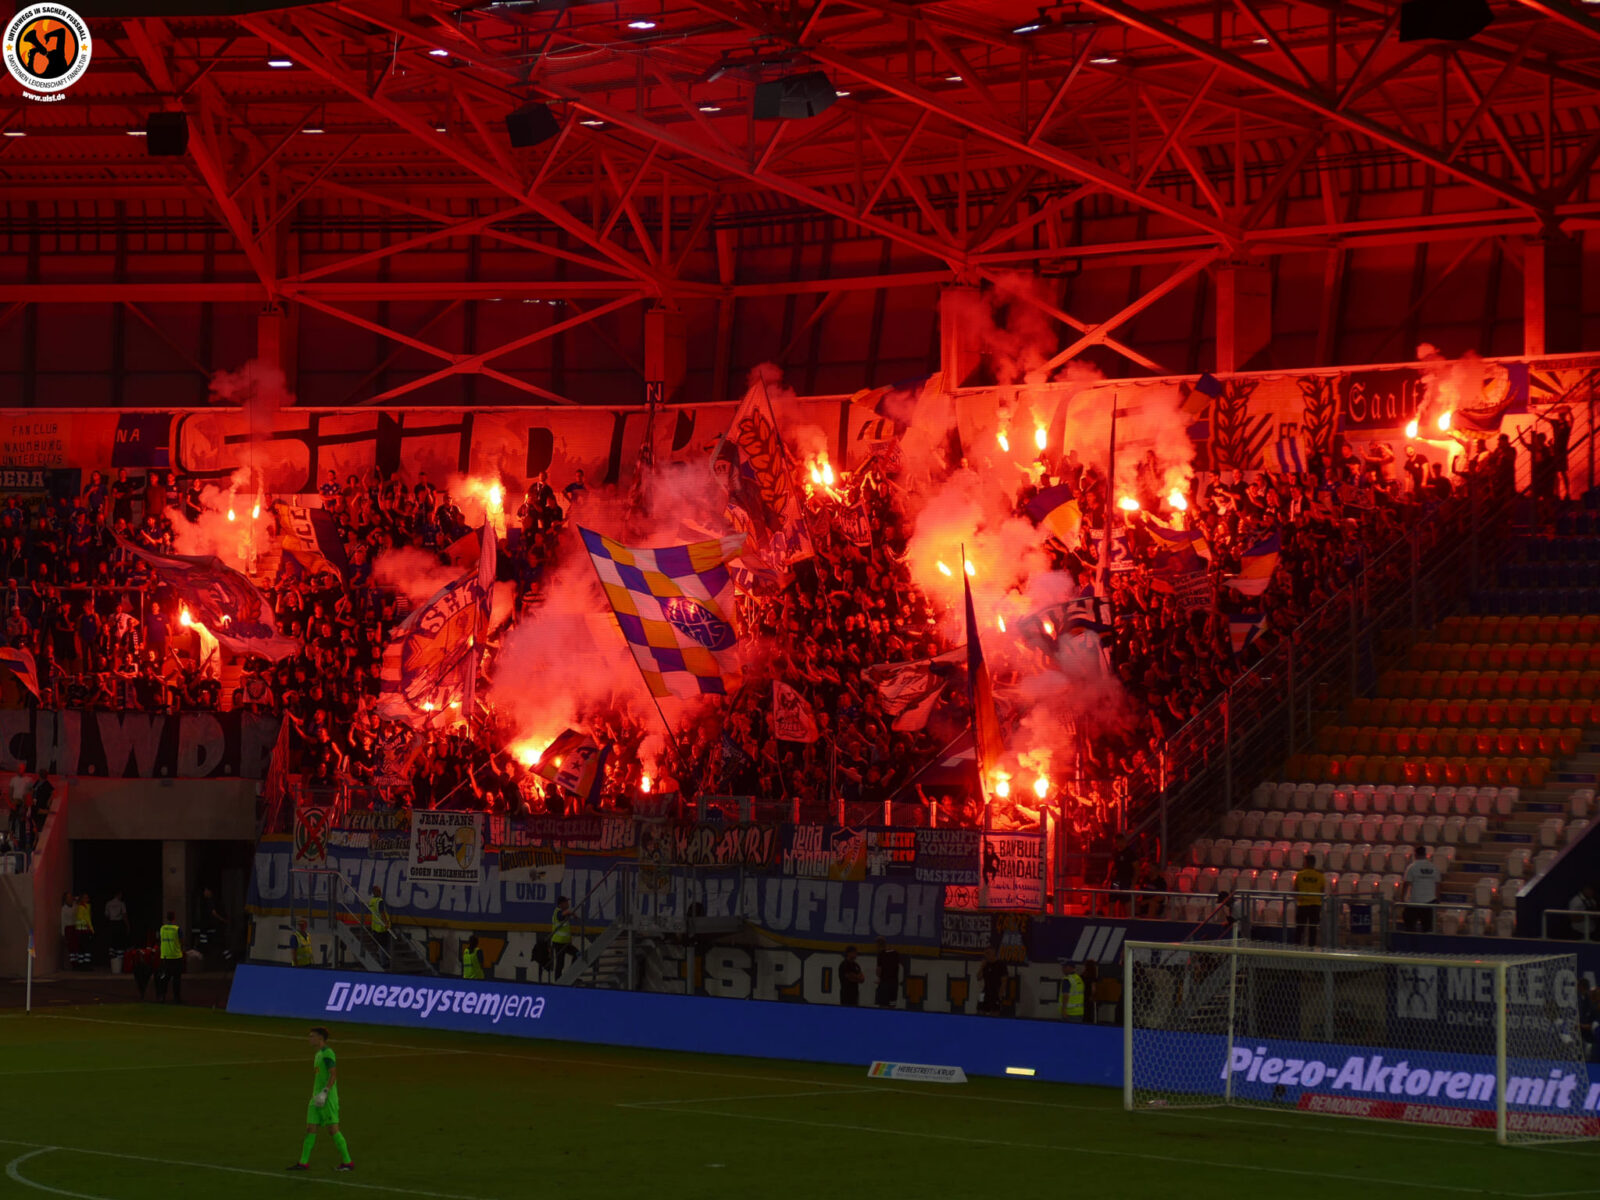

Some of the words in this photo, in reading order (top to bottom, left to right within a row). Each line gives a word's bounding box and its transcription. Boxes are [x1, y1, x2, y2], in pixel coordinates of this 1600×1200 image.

[0, 471, 45, 487] ERA
[419, 814, 474, 826] JENA-FANS
[516, 884, 546, 901] UND
[1222, 1047, 1497, 1104] Piezo-Aktoren
[1505, 1069, 1578, 1109] mit
[1308, 1096, 1373, 1116] REMONDIS
[1403, 1105, 1474, 1127] REMONDIS
[1506, 1114, 1587, 1134] REMONDIS
